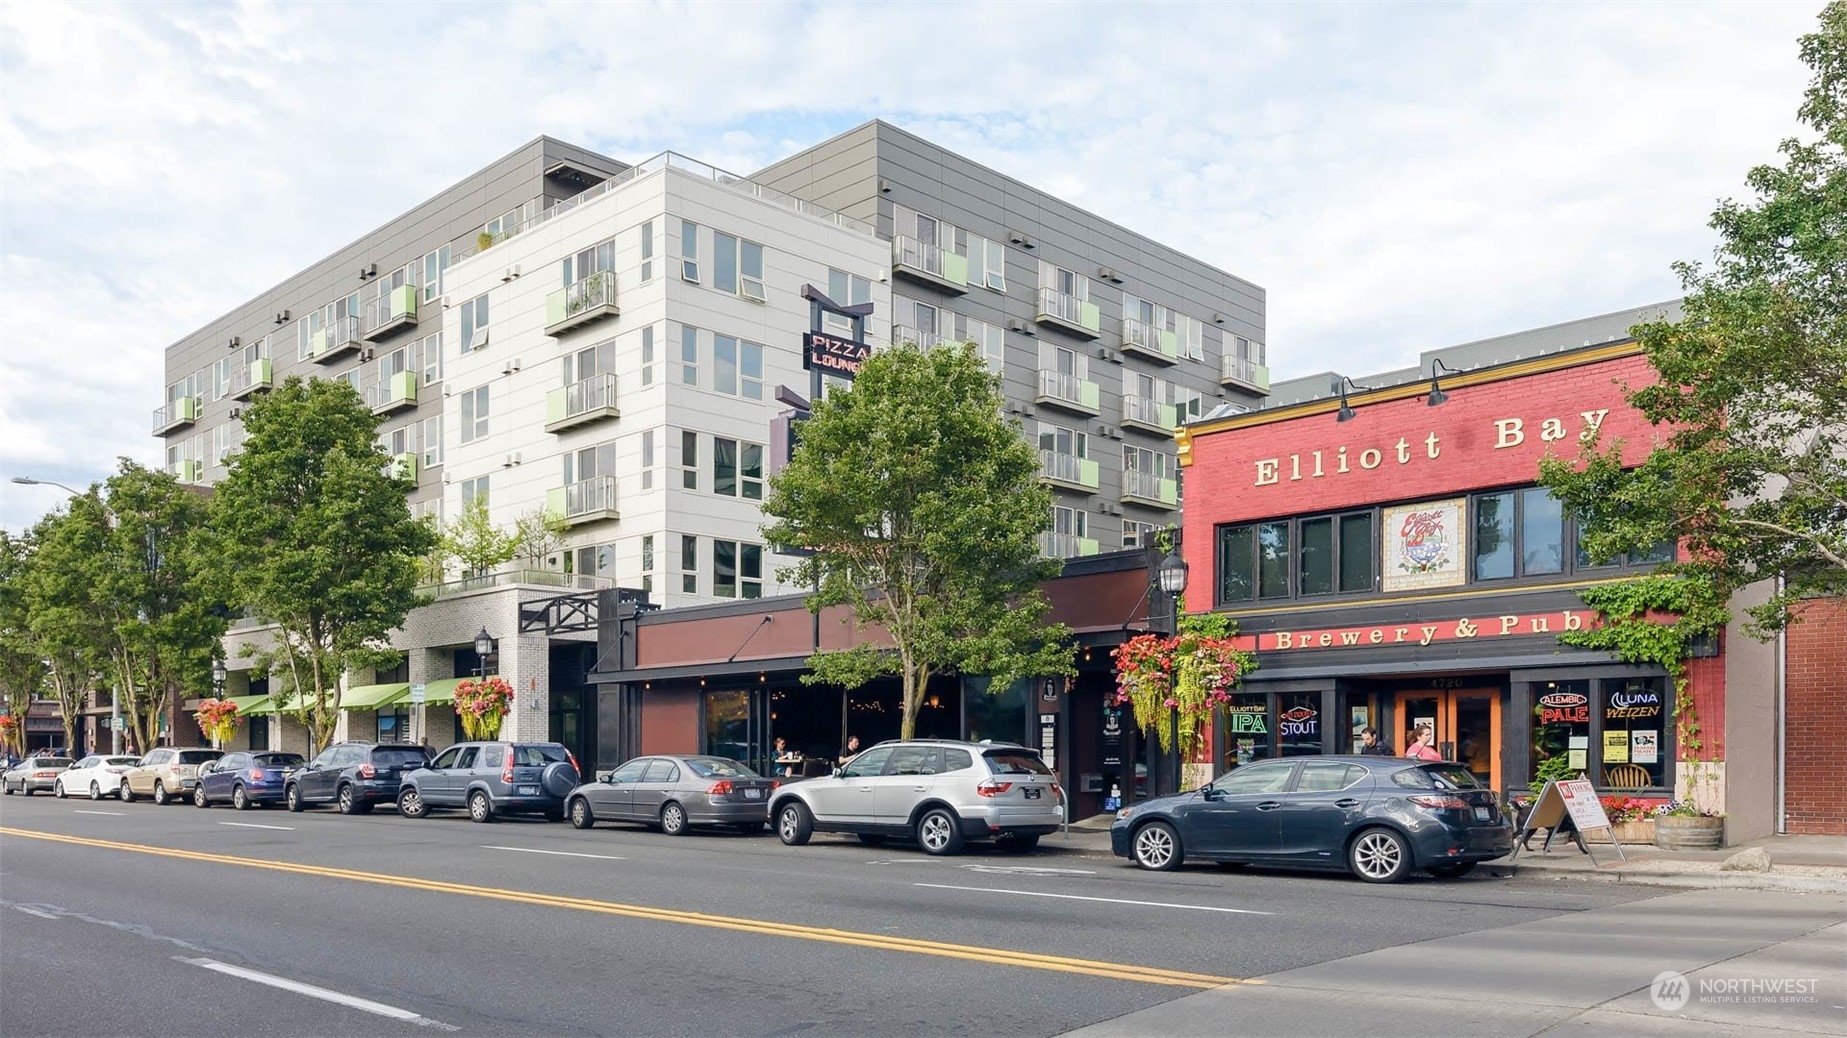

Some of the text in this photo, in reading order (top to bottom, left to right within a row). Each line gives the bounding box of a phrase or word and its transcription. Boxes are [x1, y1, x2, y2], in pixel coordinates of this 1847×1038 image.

[812, 335, 868, 359] PIZZA
[812, 352, 864, 373] LOUNG
[1254, 408, 1609, 486] Elliott Bay
[1275, 610, 1583, 650] Brewery & Pub
[1431, 678, 1463, 688] 4720
[1543, 695, 1584, 705] ALEMBIC
[1619, 693, 1659, 705] LUNA
[1540, 706, 1589, 724] PALE
[1606, 705, 1660, 719] WEIZEN
[1231, 713, 1267, 734] IPA
[1280, 720, 1317, 736] STOUT
